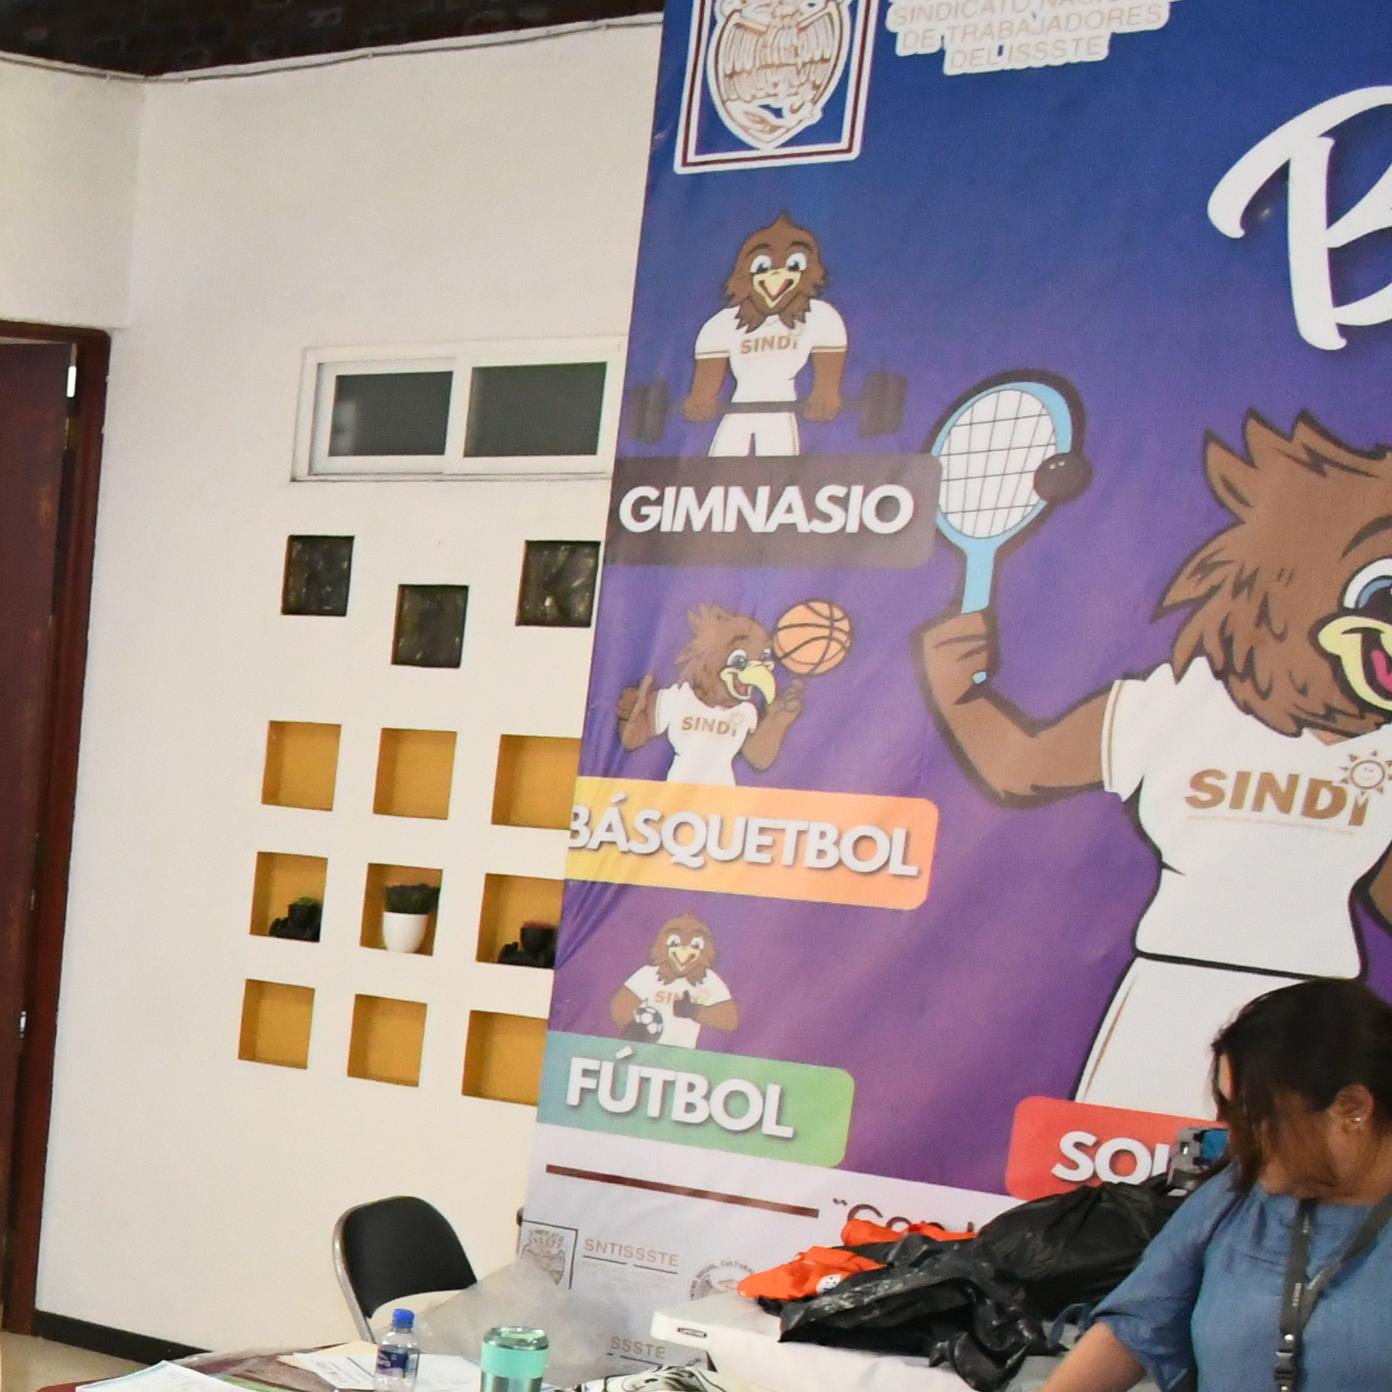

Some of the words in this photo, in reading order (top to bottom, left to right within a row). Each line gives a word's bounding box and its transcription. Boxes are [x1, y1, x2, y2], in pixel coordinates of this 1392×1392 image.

[902, 30, 937, 50] DE
[947, 5, 1163, 43] TRABAJADORES
[950, 46, 1000, 69] DEL
[1007, 35, 1104, 63] ISSSTE
[619, 485, 914, 534] GIMNASIO
[568, 792, 920, 876] BÁSQUETBOL
[566, 1045, 794, 1138] FÚTBOL
[584, 1238, 679, 1268] SNTISSSTE
